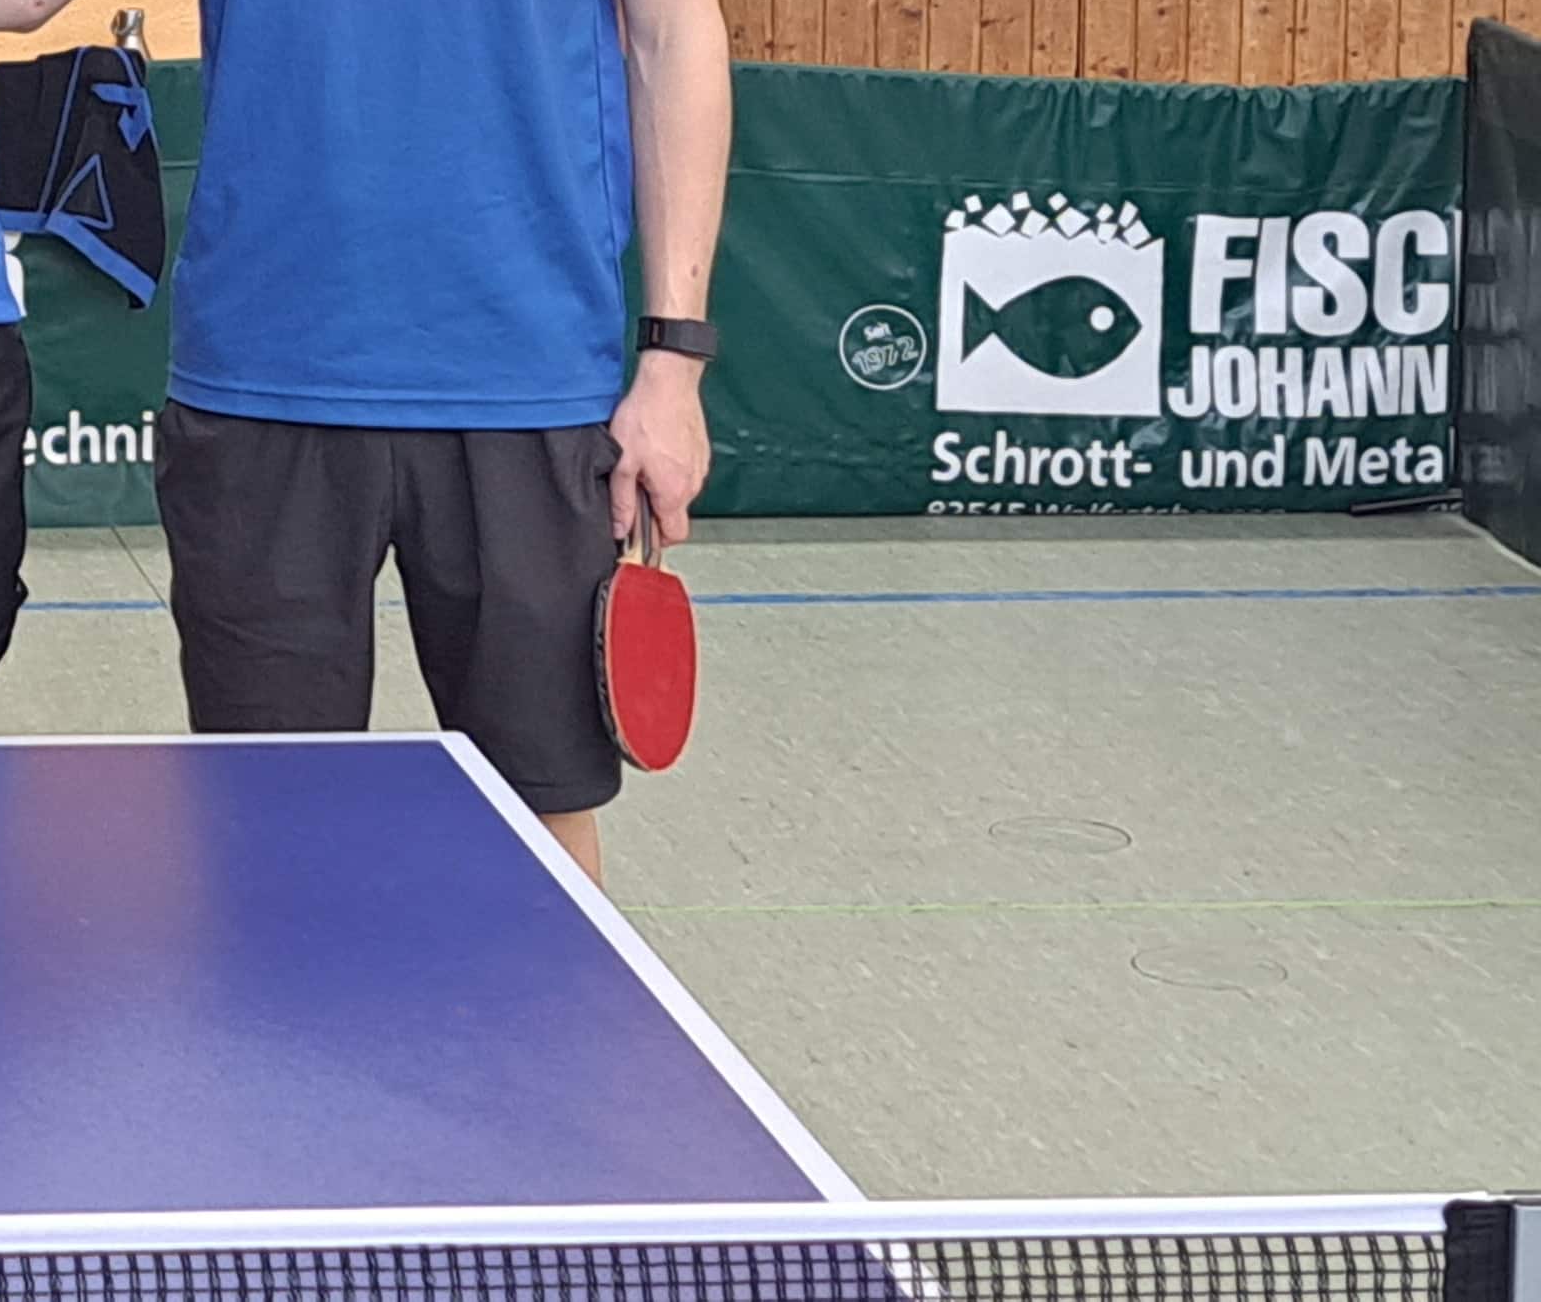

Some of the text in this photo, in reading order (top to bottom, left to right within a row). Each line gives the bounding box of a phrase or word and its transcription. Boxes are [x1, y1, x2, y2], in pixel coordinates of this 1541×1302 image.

[1190, 209, 1462, 336] FISC
[851, 335, 919, 376] 1972
[1167, 344, 1449, 419] JOHANN
[930, 430, 1153, 488] Schrott-
[1180, 433, 1285, 488] und
